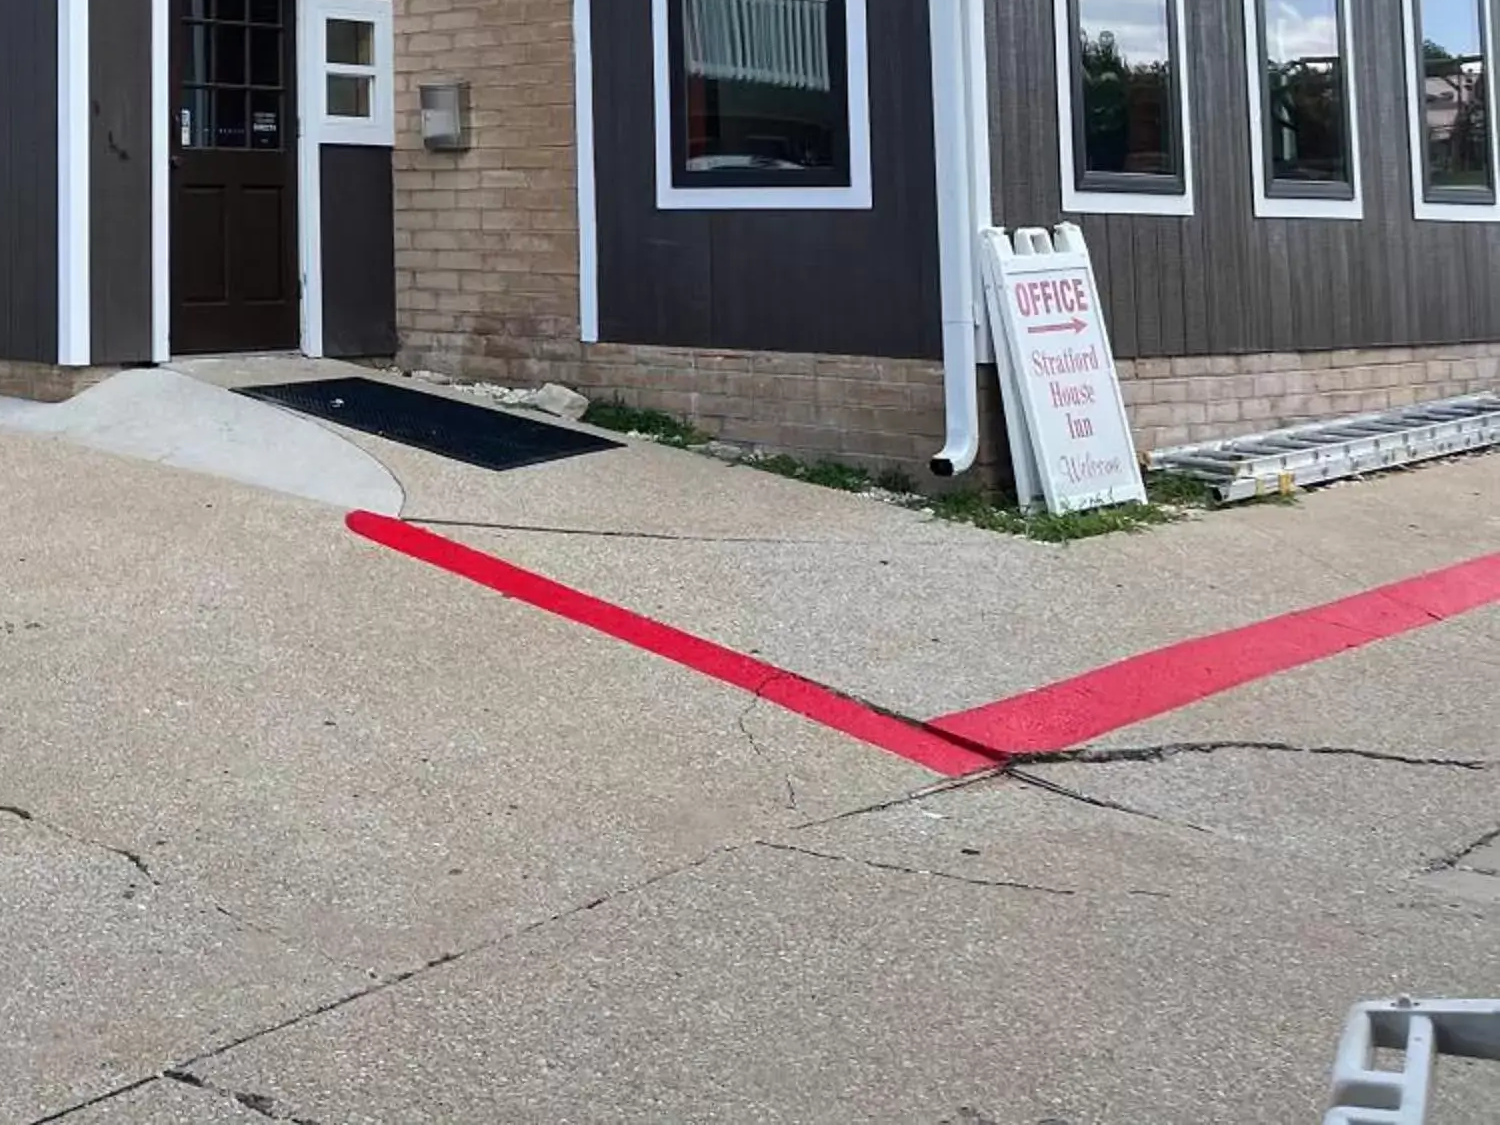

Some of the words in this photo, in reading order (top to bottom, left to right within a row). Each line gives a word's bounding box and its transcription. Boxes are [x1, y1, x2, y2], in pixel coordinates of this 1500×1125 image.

[1014, 278, 1089, 318] OFFICE
[1031, 344, 1099, 376] Stratford
[1049, 381, 1097, 409] House
[1065, 412, 1095, 441] Inn
